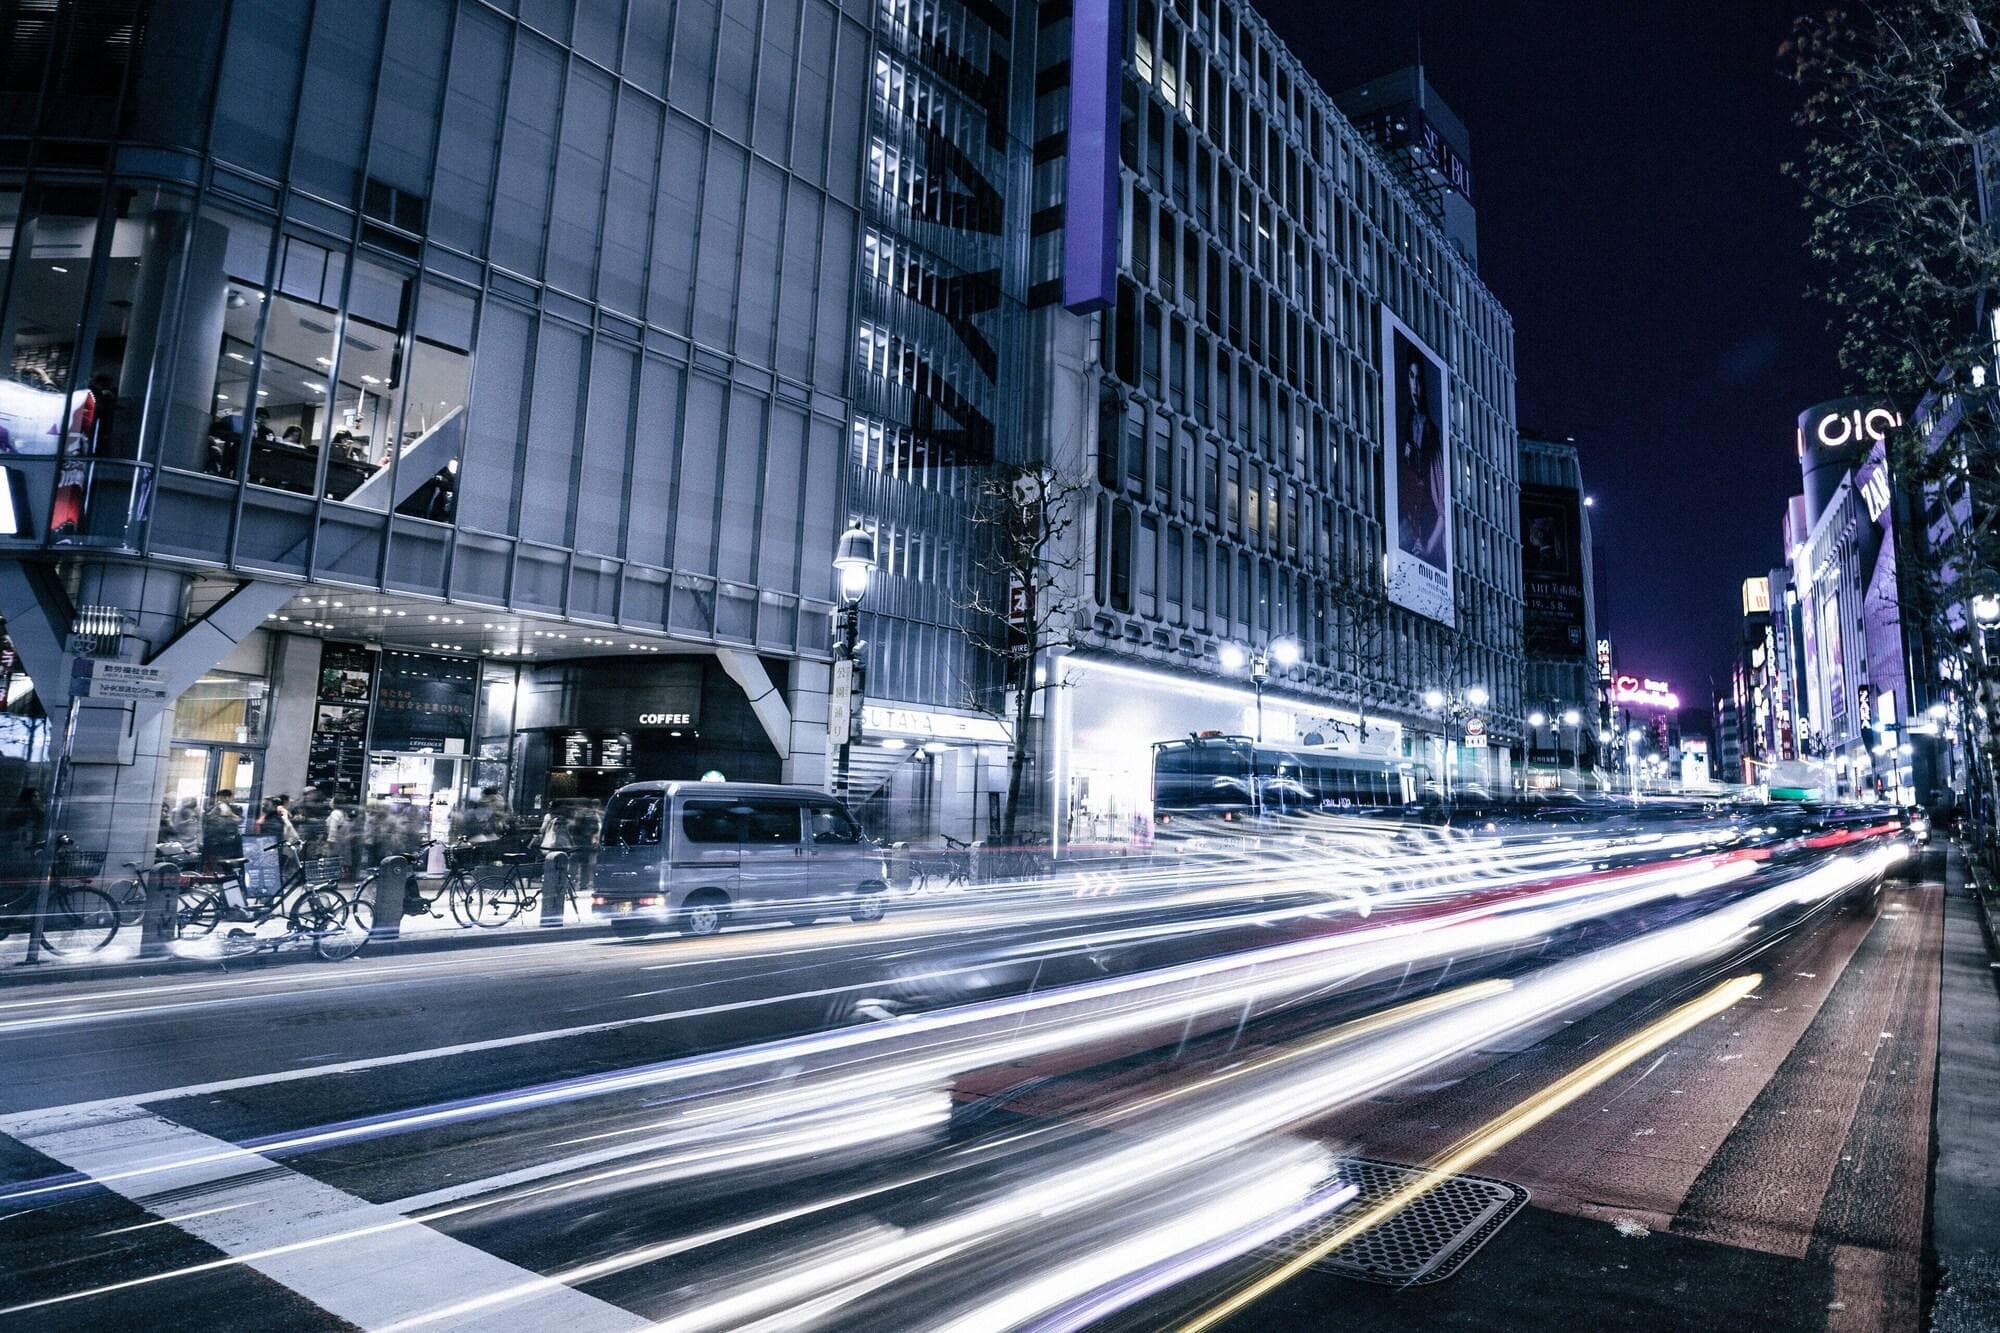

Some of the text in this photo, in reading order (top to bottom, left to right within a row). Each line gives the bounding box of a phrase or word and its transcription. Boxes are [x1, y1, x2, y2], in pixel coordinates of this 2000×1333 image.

[1424, 122, 1471, 198] SEIBU
[1860, 458, 1891, 523] ZAR
[639, 713, 690, 724] COFFEE
[863, 708, 933, 732] UTAYA
